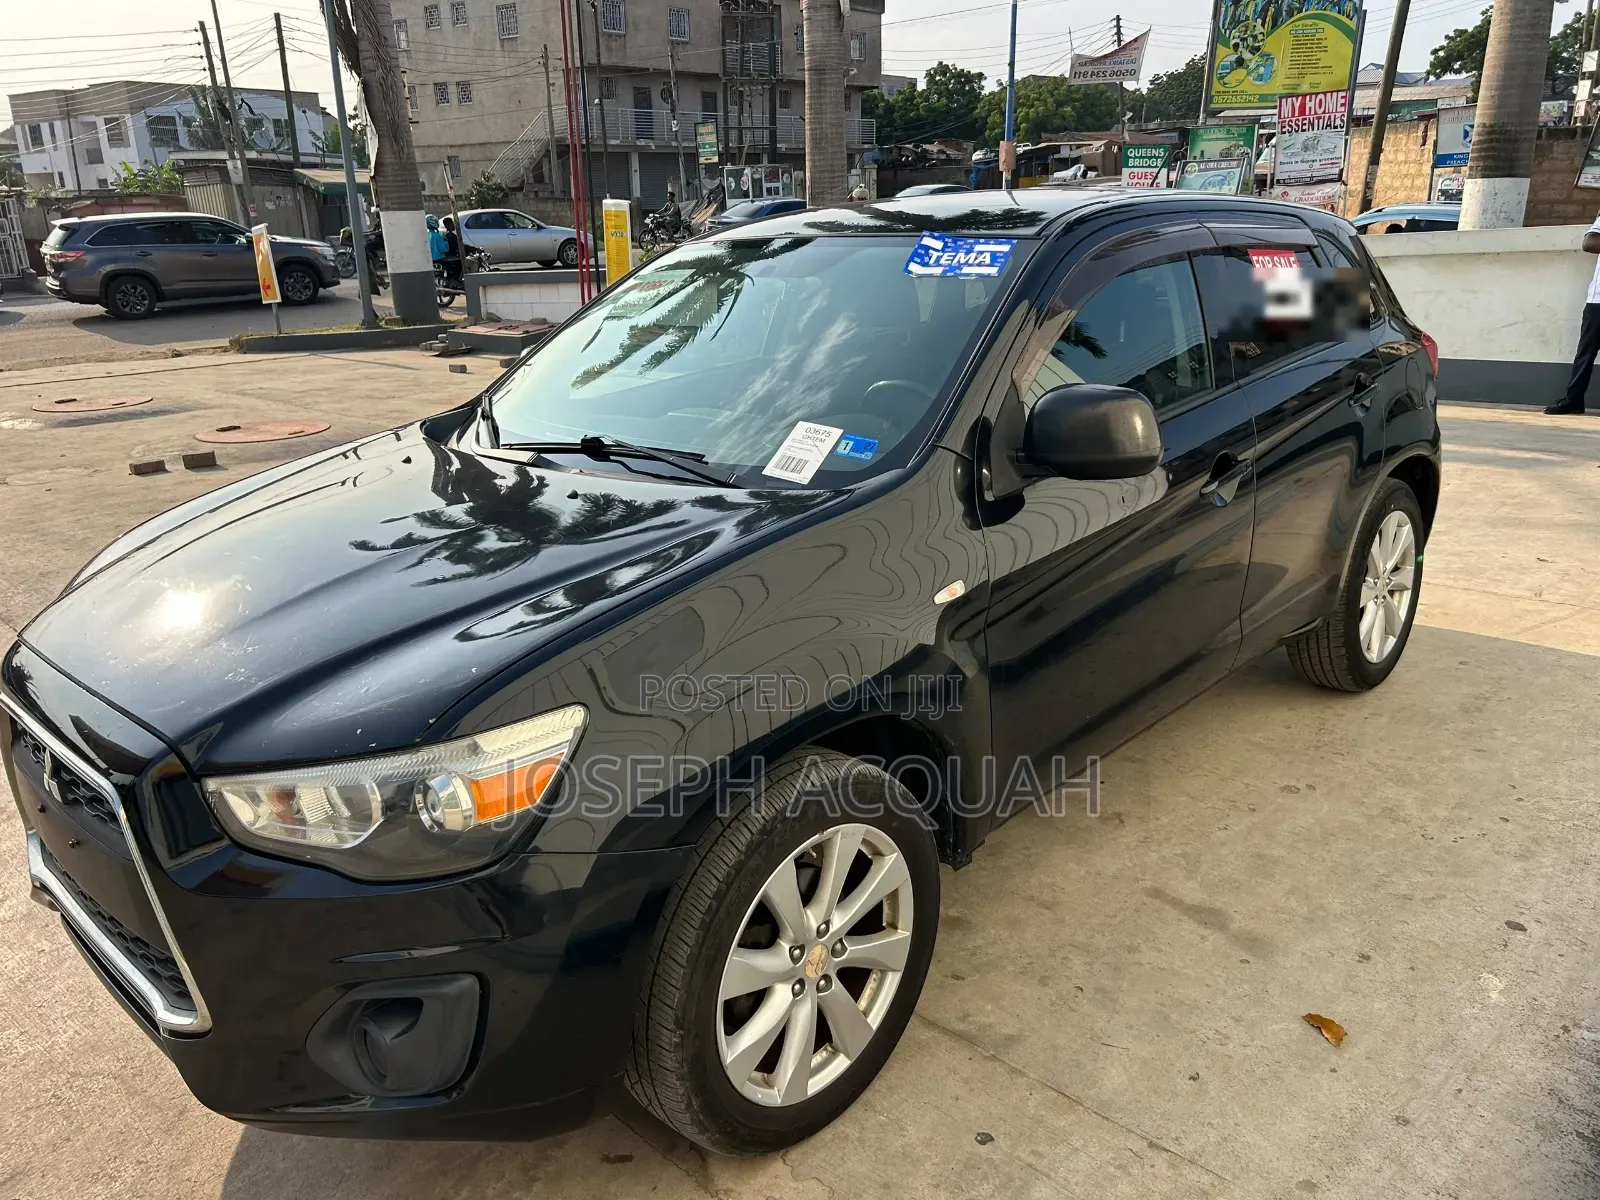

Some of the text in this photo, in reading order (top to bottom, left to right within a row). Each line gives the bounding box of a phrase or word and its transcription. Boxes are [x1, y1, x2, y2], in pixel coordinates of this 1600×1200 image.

[1213, 95, 1259, 103] 0572652142
[1280, 91, 1347, 118] MY HOME
[1280, 113, 1345, 135] ESSENTIALS
[1127, 148, 1165, 157] QUEENS
[1128, 158, 1162, 167] BRIDGE
[928, 249, 992, 265] TEMA
[1252, 256, 1298, 268] FOR SALE
[804, 426, 833, 438] 03675
[842, 441, 850, 451] 1
